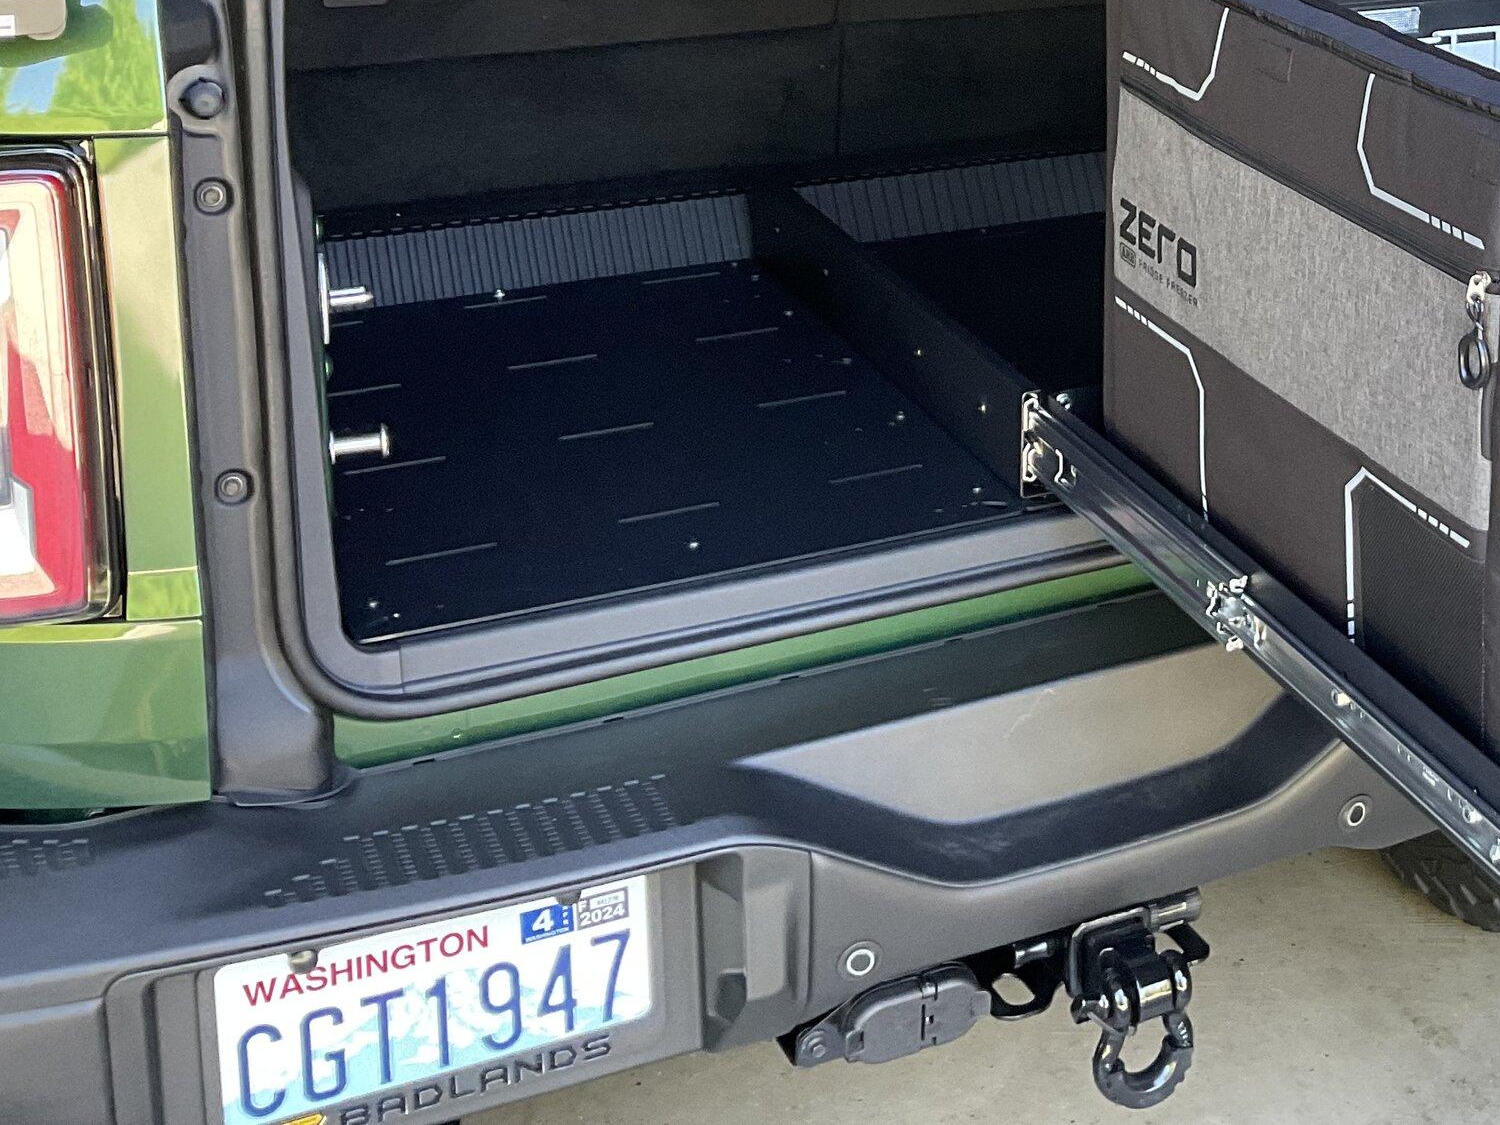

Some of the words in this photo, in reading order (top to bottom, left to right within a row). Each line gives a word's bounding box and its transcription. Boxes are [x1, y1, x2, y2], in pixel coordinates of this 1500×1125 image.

[531, 908, 555, 933] 4
[580, 902, 625, 927] 2024
[243, 925, 490, 1007] WASHINGTON
[237, 928, 632, 1117] CGT1947
[340, 1033, 613, 1125] BADLANDS
